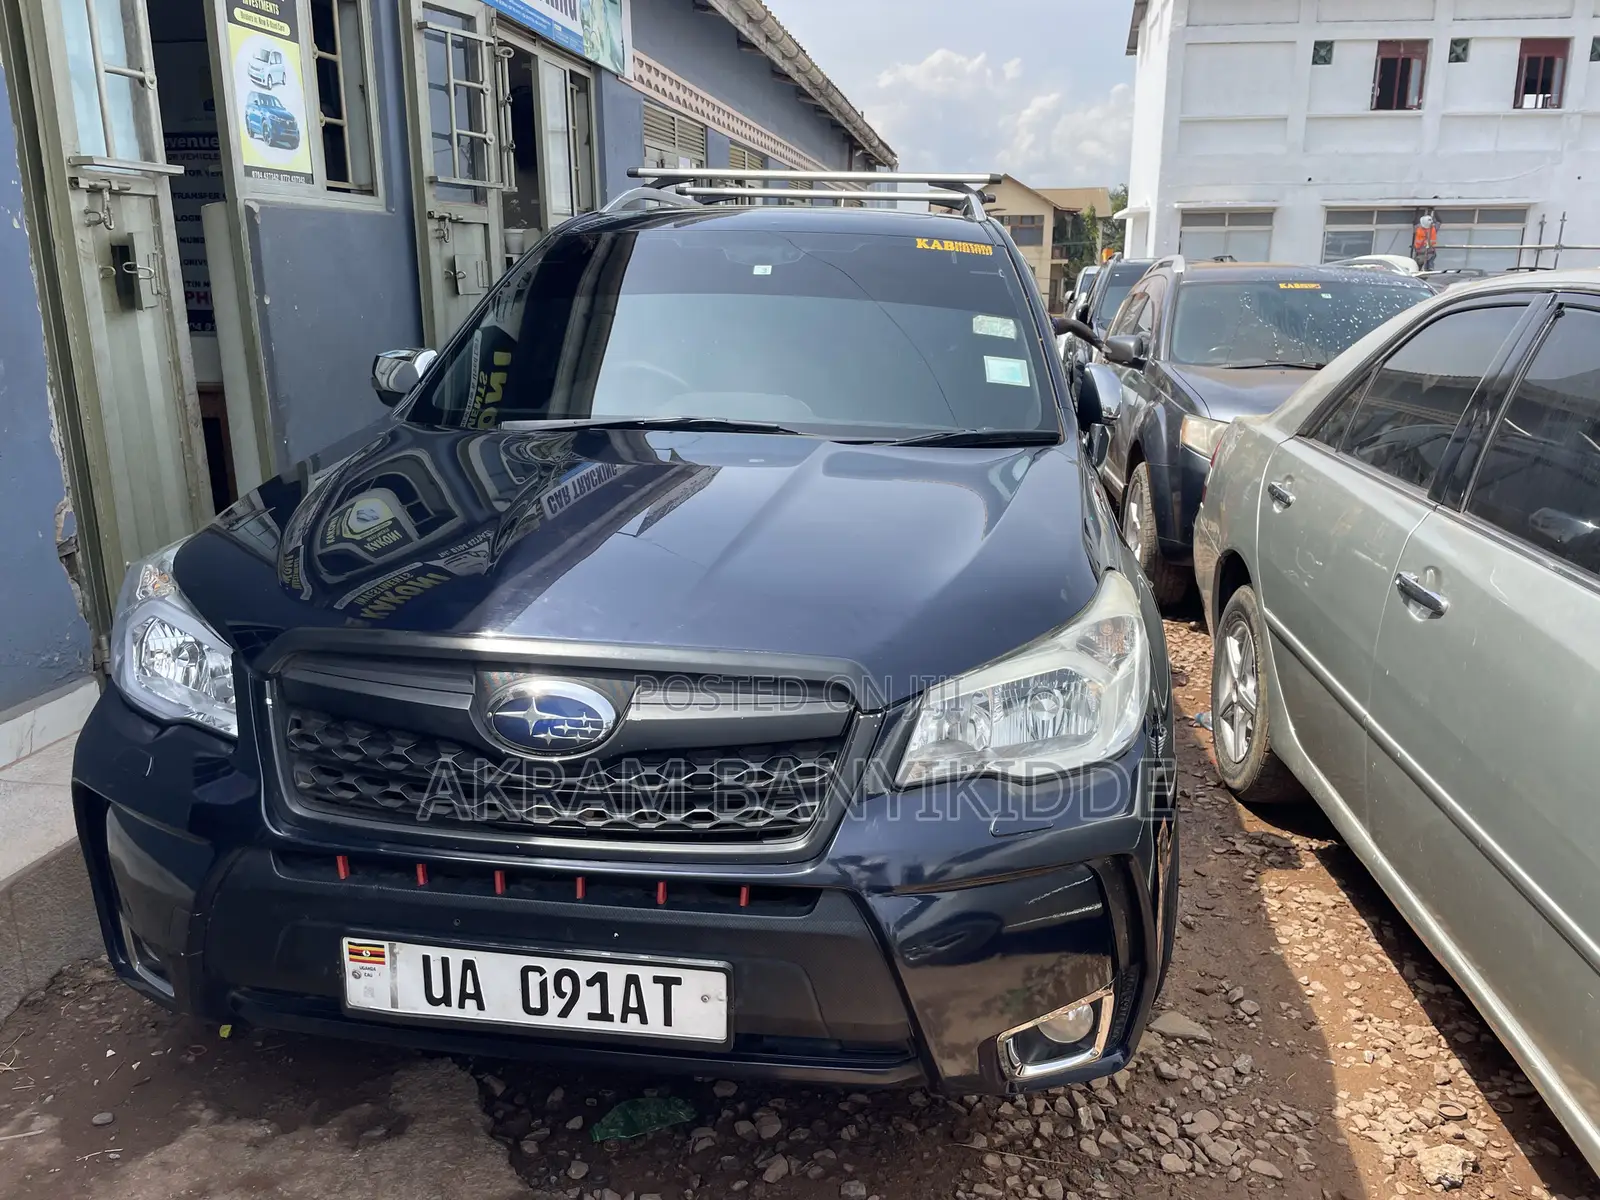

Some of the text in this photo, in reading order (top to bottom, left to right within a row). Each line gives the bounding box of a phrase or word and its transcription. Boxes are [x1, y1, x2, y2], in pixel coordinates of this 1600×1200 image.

[164, 136, 219, 149] venue
[916, 238, 955, 251] KAB
[422, 954, 683, 1027] UA 091AT
